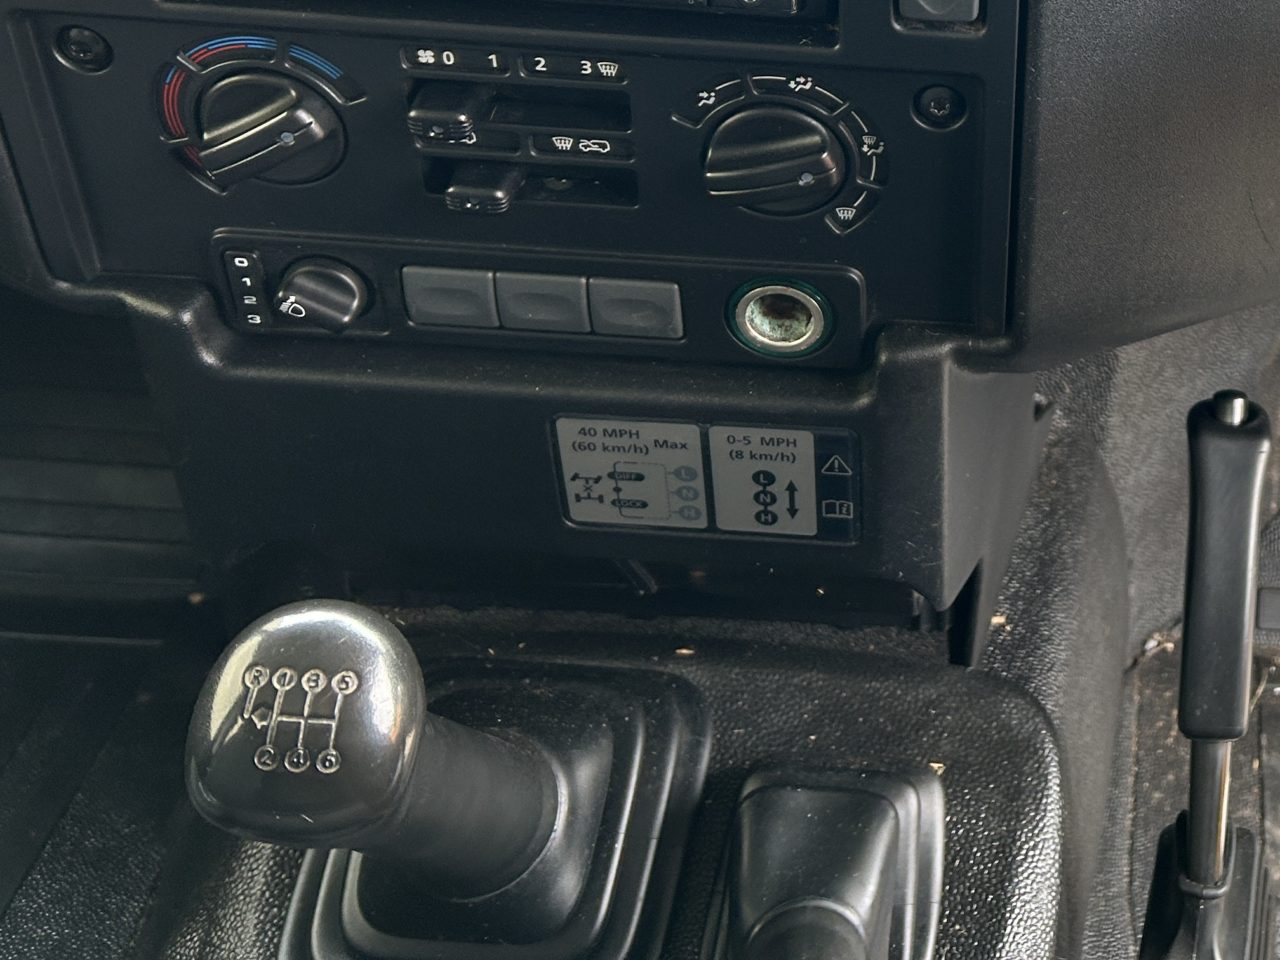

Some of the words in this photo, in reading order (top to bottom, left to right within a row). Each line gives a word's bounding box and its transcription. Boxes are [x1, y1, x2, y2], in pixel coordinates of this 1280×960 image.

[442, 51, 455, 65] 0
[488, 54, 498, 68] 1
[534, 57, 547, 71] 2
[580, 60, 592, 74] 3
[234, 257, 249, 267] 0
[241, 277, 251, 287] 1
[244, 295, 257, 304] 2
[247, 314, 261, 324] 3
[578, 427, 597, 438] 40
[603, 428, 640, 440] MPH
[654, 439, 688, 450] Max
[726, 435, 752, 445] 0-5
[760, 437, 797, 448] MPH
[572, 441, 597, 453] (60
[602, 442, 650, 456] km/h)
[729, 450, 744, 461] (8
[750, 450, 796, 464] km/h)
[758, 473, 768, 483] L
[760, 494, 772, 504] N
[761, 513, 772, 523] H
[338, 674, 353, 690] 5
[259, 748, 276, 766] 2
